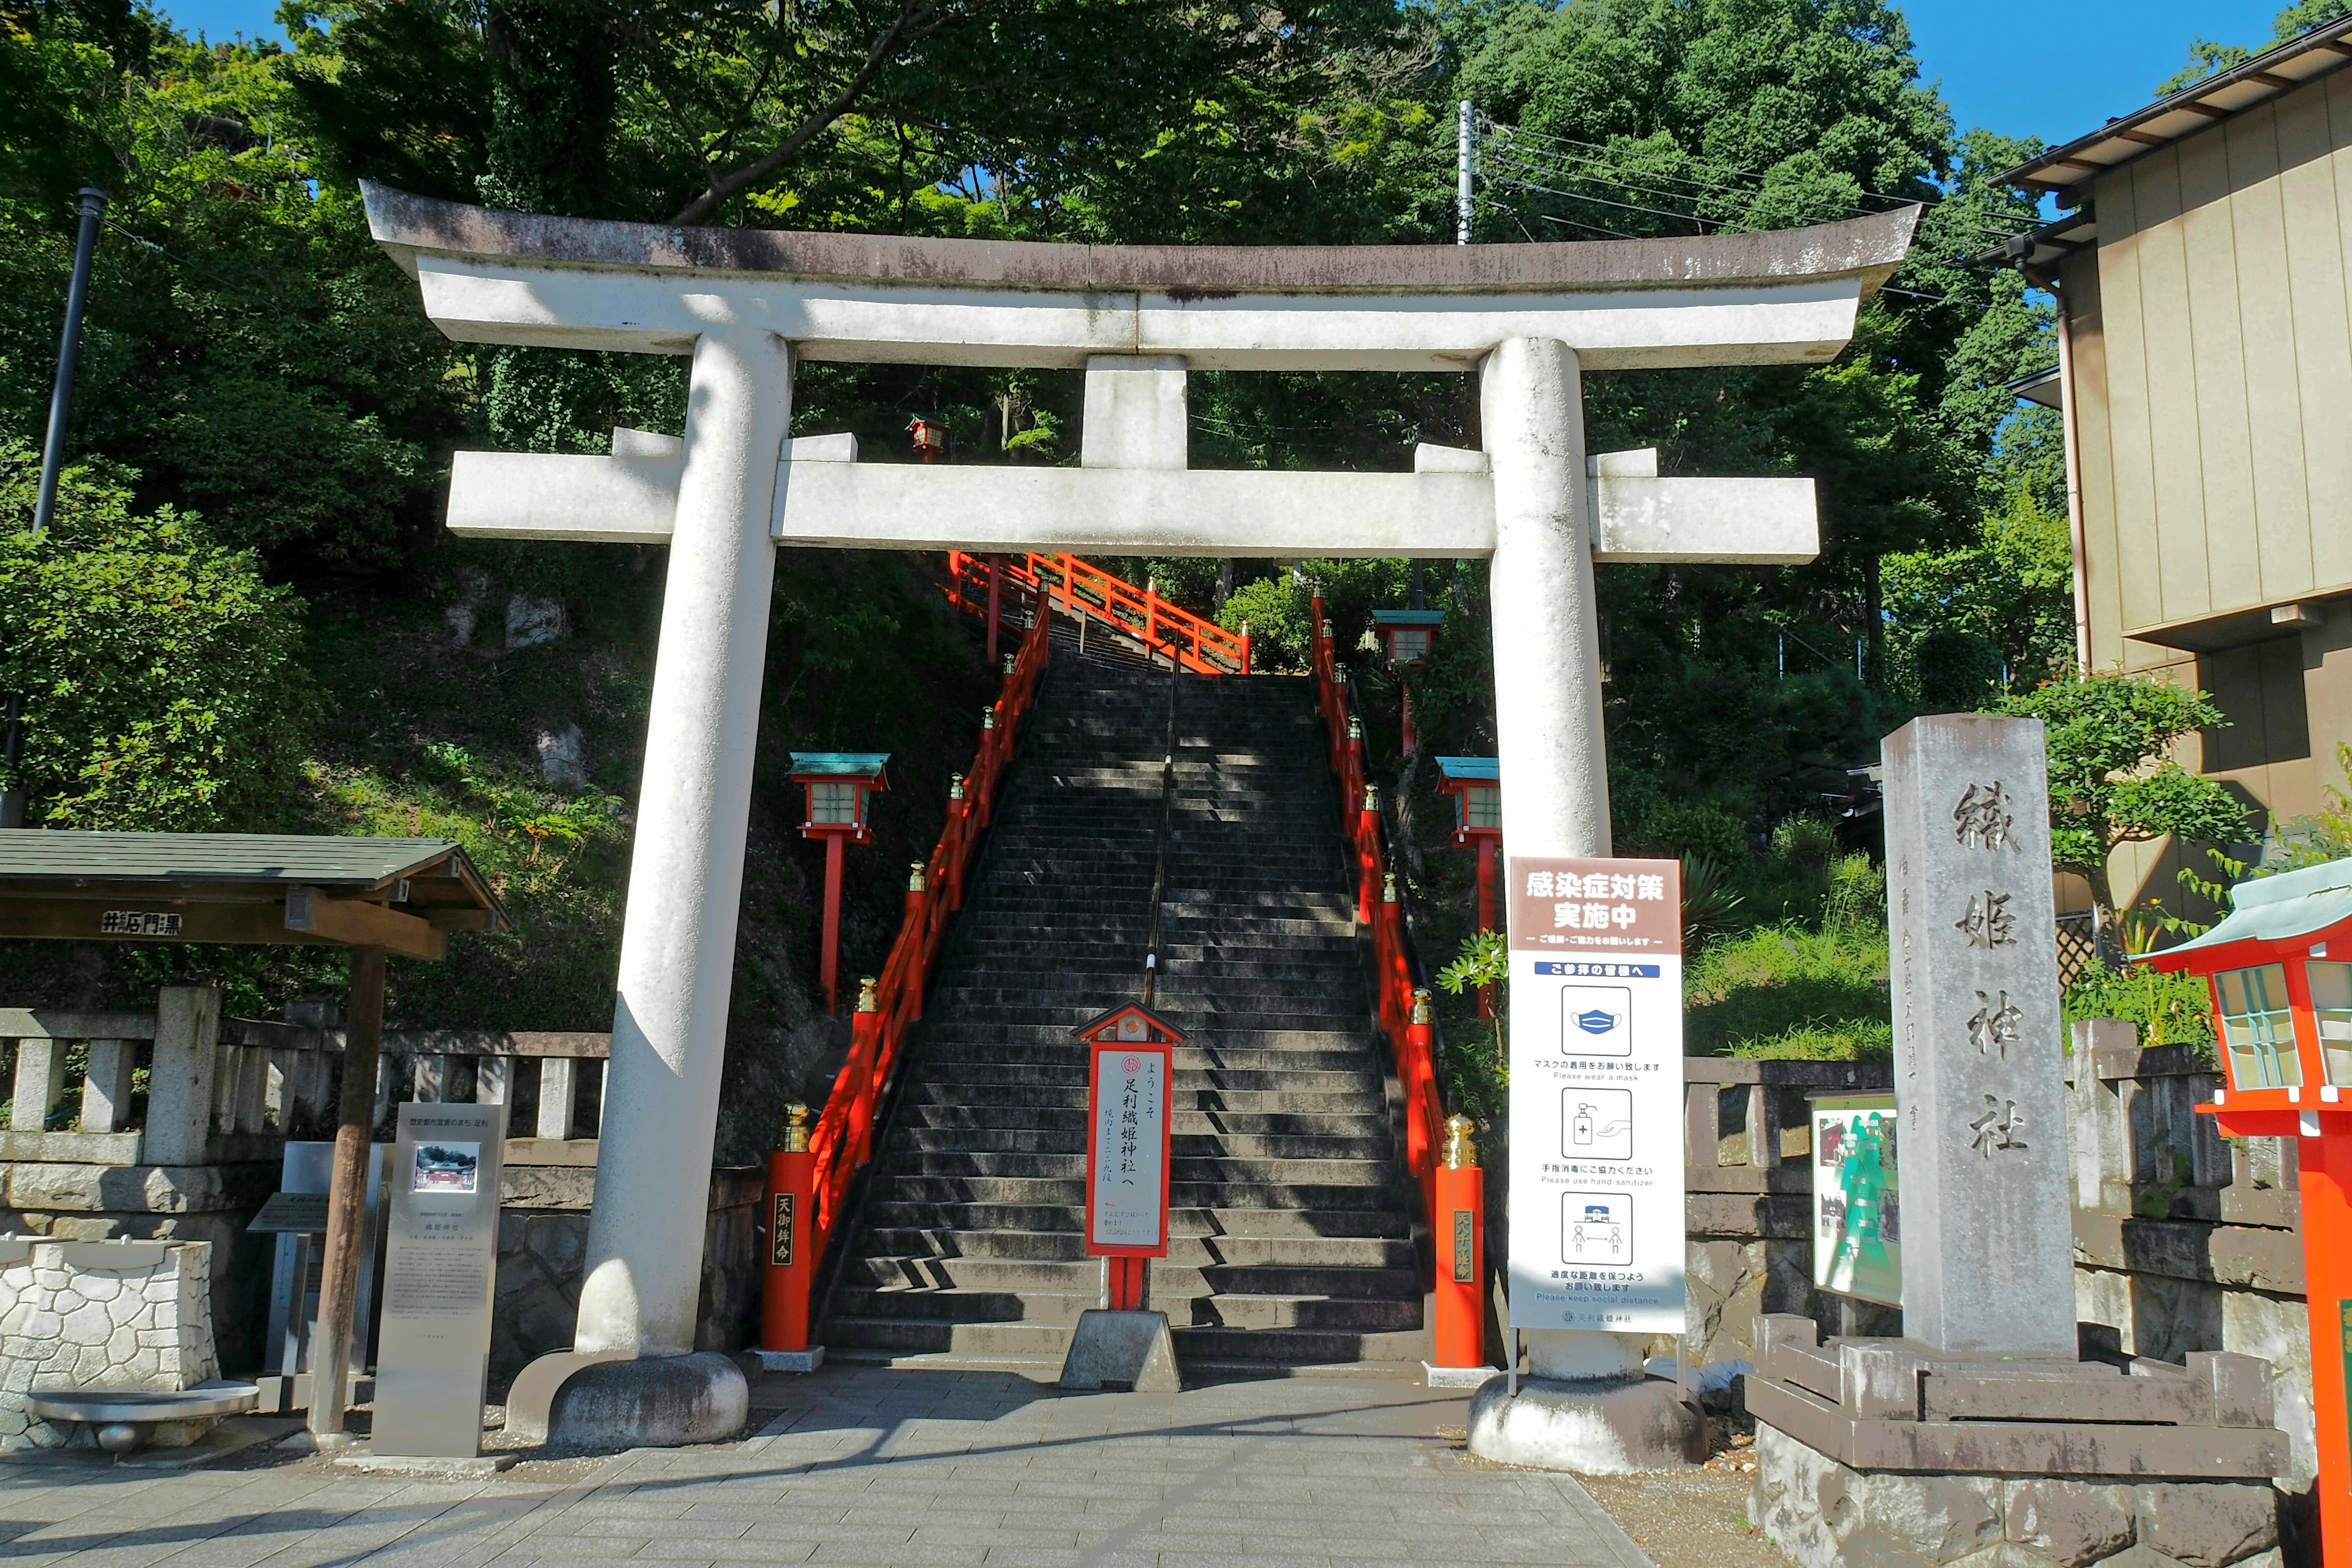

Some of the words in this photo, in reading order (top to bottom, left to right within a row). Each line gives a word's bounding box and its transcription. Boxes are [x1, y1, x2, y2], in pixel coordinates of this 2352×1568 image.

[1526, 870, 1664, 900] 感染症対策
[1554, 902, 1637, 930] 実施中
[1551, 963, 1643, 977] ご参拝の皆様へ
[1953, 779, 2030, 1159] 織姫神社
[1533, 1060, 1660, 1072] マスクの着用をお願い致します
[1146, 1062, 1156, 1118] ようこそ
[1120, 1078, 1139, 1186] 足利織姫神社へ
[1542, 1163, 1653, 1175] 手指消毒にご協力ください
[1591, 1177, 1654, 1186] hand-sanitizer
[1565, 1281, 1630, 1292] お願い致します
[1536, 1292, 1566, 1301] Please
[1568, 1294, 1589, 1303] keep
[1592, 1295, 1618, 1304] social
[1620, 1296, 1659, 1305] distance
